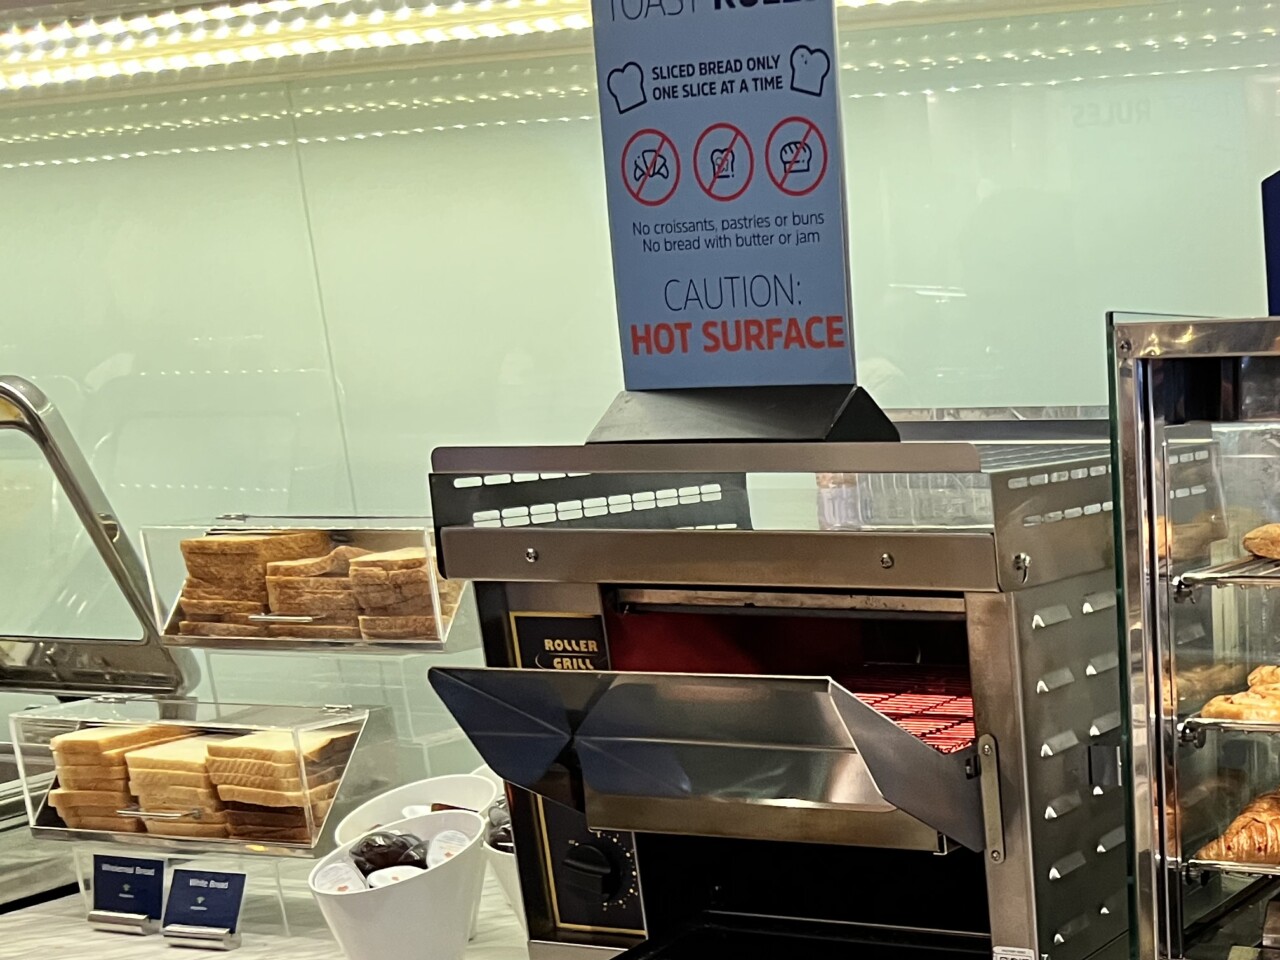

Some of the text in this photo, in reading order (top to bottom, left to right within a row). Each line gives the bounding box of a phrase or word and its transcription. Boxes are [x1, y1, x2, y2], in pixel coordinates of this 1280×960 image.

[651, 54, 781, 81] SLICED BREAD ONLY
[652, 75, 784, 101] ONE SLICE AT A TIME
[631, 211, 825, 236] No croissants, pastries or buns
[641, 229, 821, 253] No bread with butter or jam
[663, 272, 803, 312] CAUTION:
[629, 314, 846, 356] HOT SURFACE
[543, 639, 598, 652] ROLLER
[552, 657, 595, 670] GRILL
